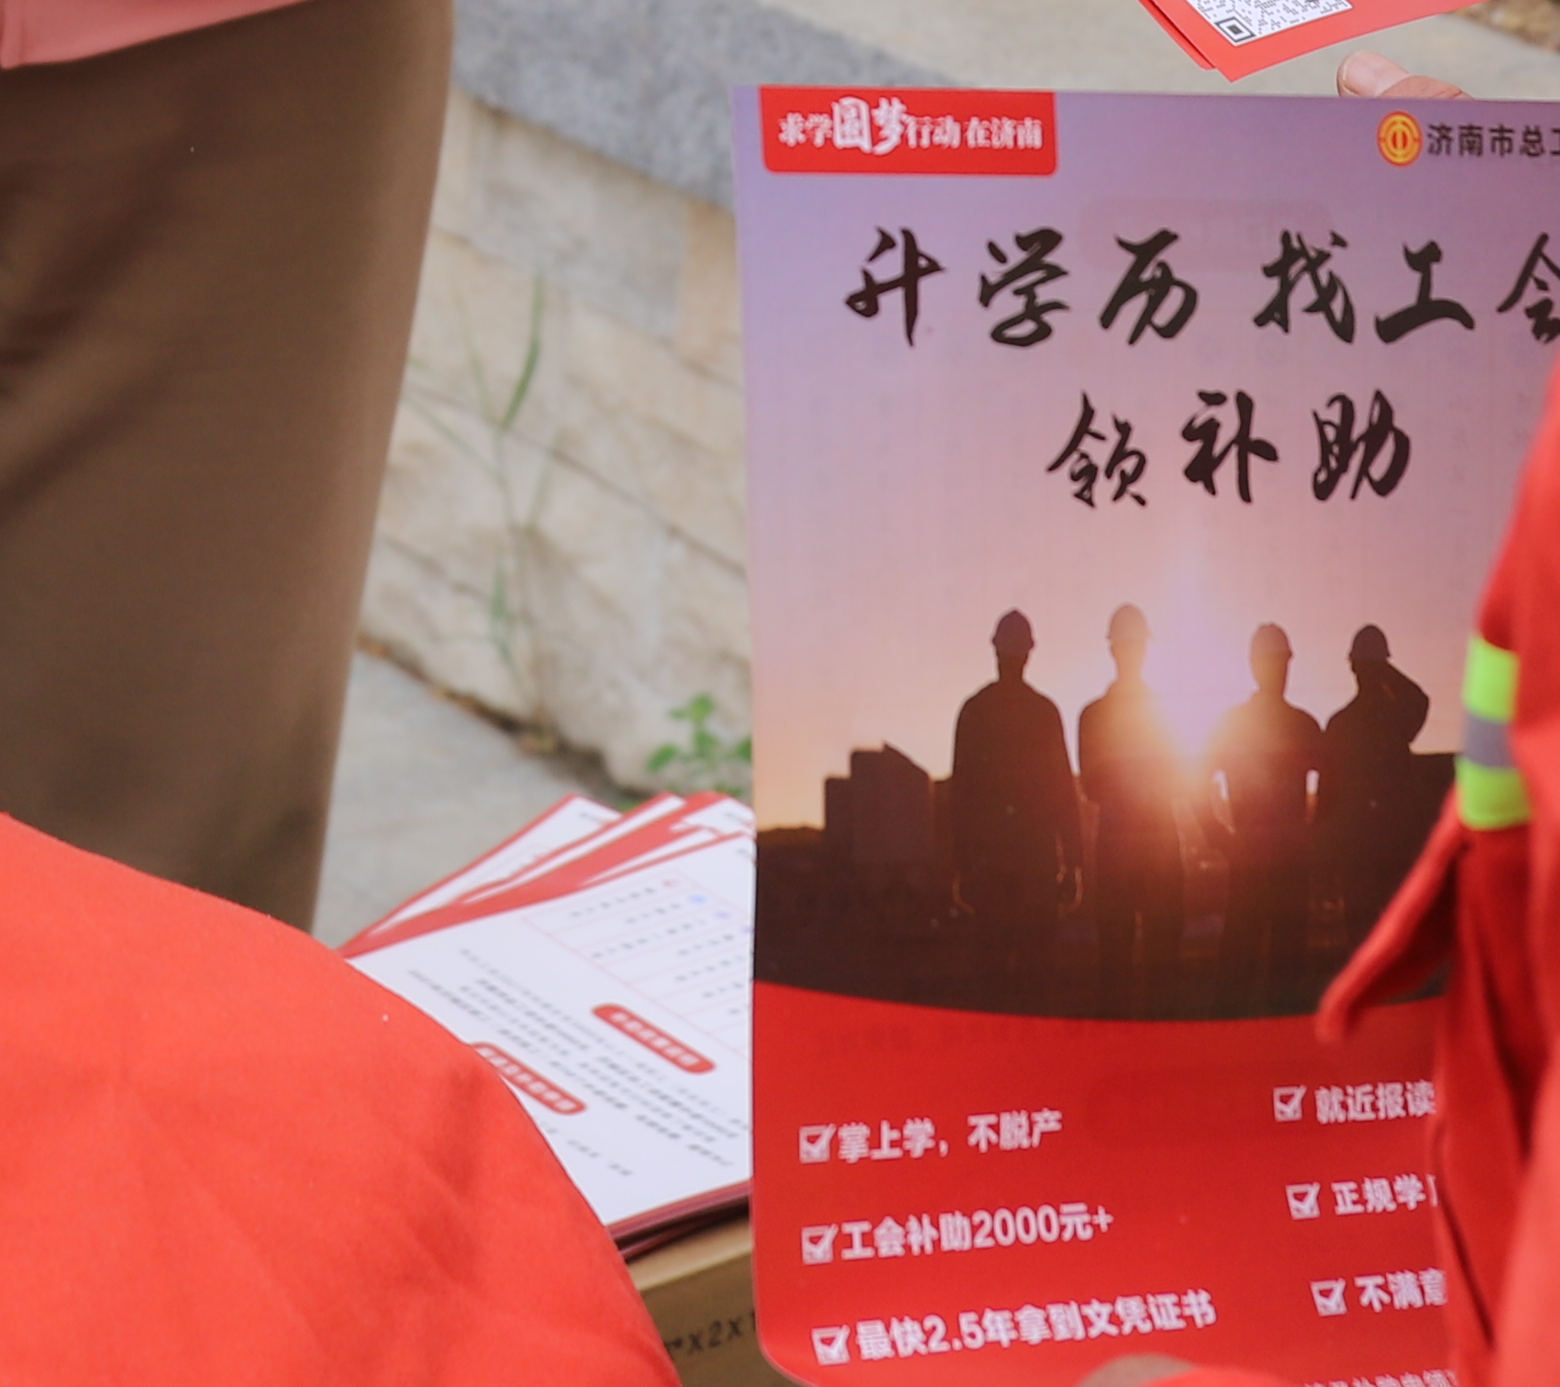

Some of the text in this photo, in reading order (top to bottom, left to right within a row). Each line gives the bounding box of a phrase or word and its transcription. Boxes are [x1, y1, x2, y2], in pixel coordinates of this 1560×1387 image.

[1048, 390, 1410, 508] 领补助
[1331, 1173, 1438, 1216] 正规学
[840, 1202, 1114, 1260] 工会补助2000元+
[856, 1288, 1217, 1361] 最快2.5年拿到文凭证书
